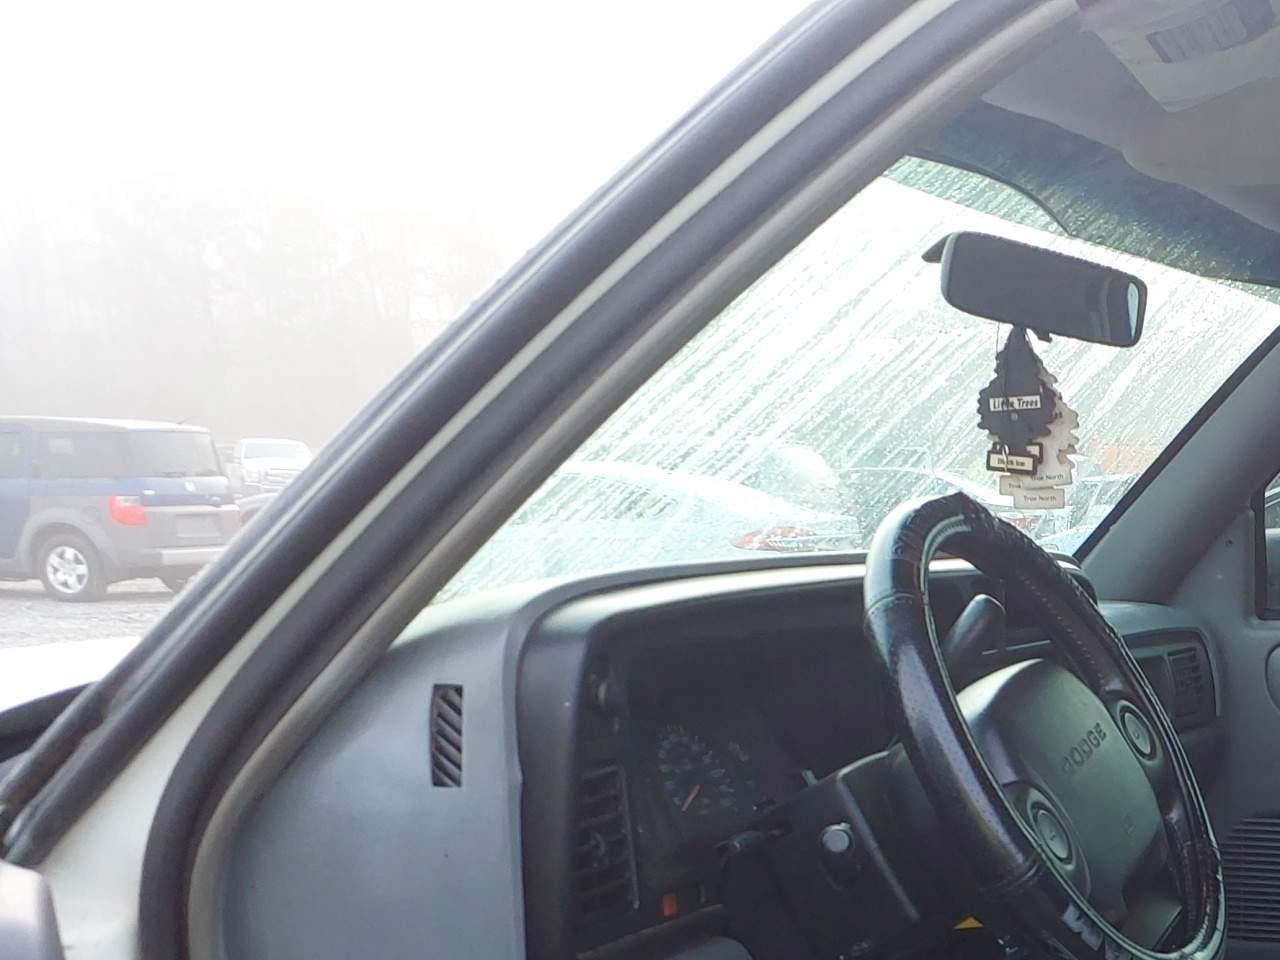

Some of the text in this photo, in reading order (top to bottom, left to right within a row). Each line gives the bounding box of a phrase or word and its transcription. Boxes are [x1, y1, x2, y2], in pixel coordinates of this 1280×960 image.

[1017, 397, 1039, 409] Trees
[1045, 473, 1064, 481] North
[1062, 722, 1107, 776] DODGE
